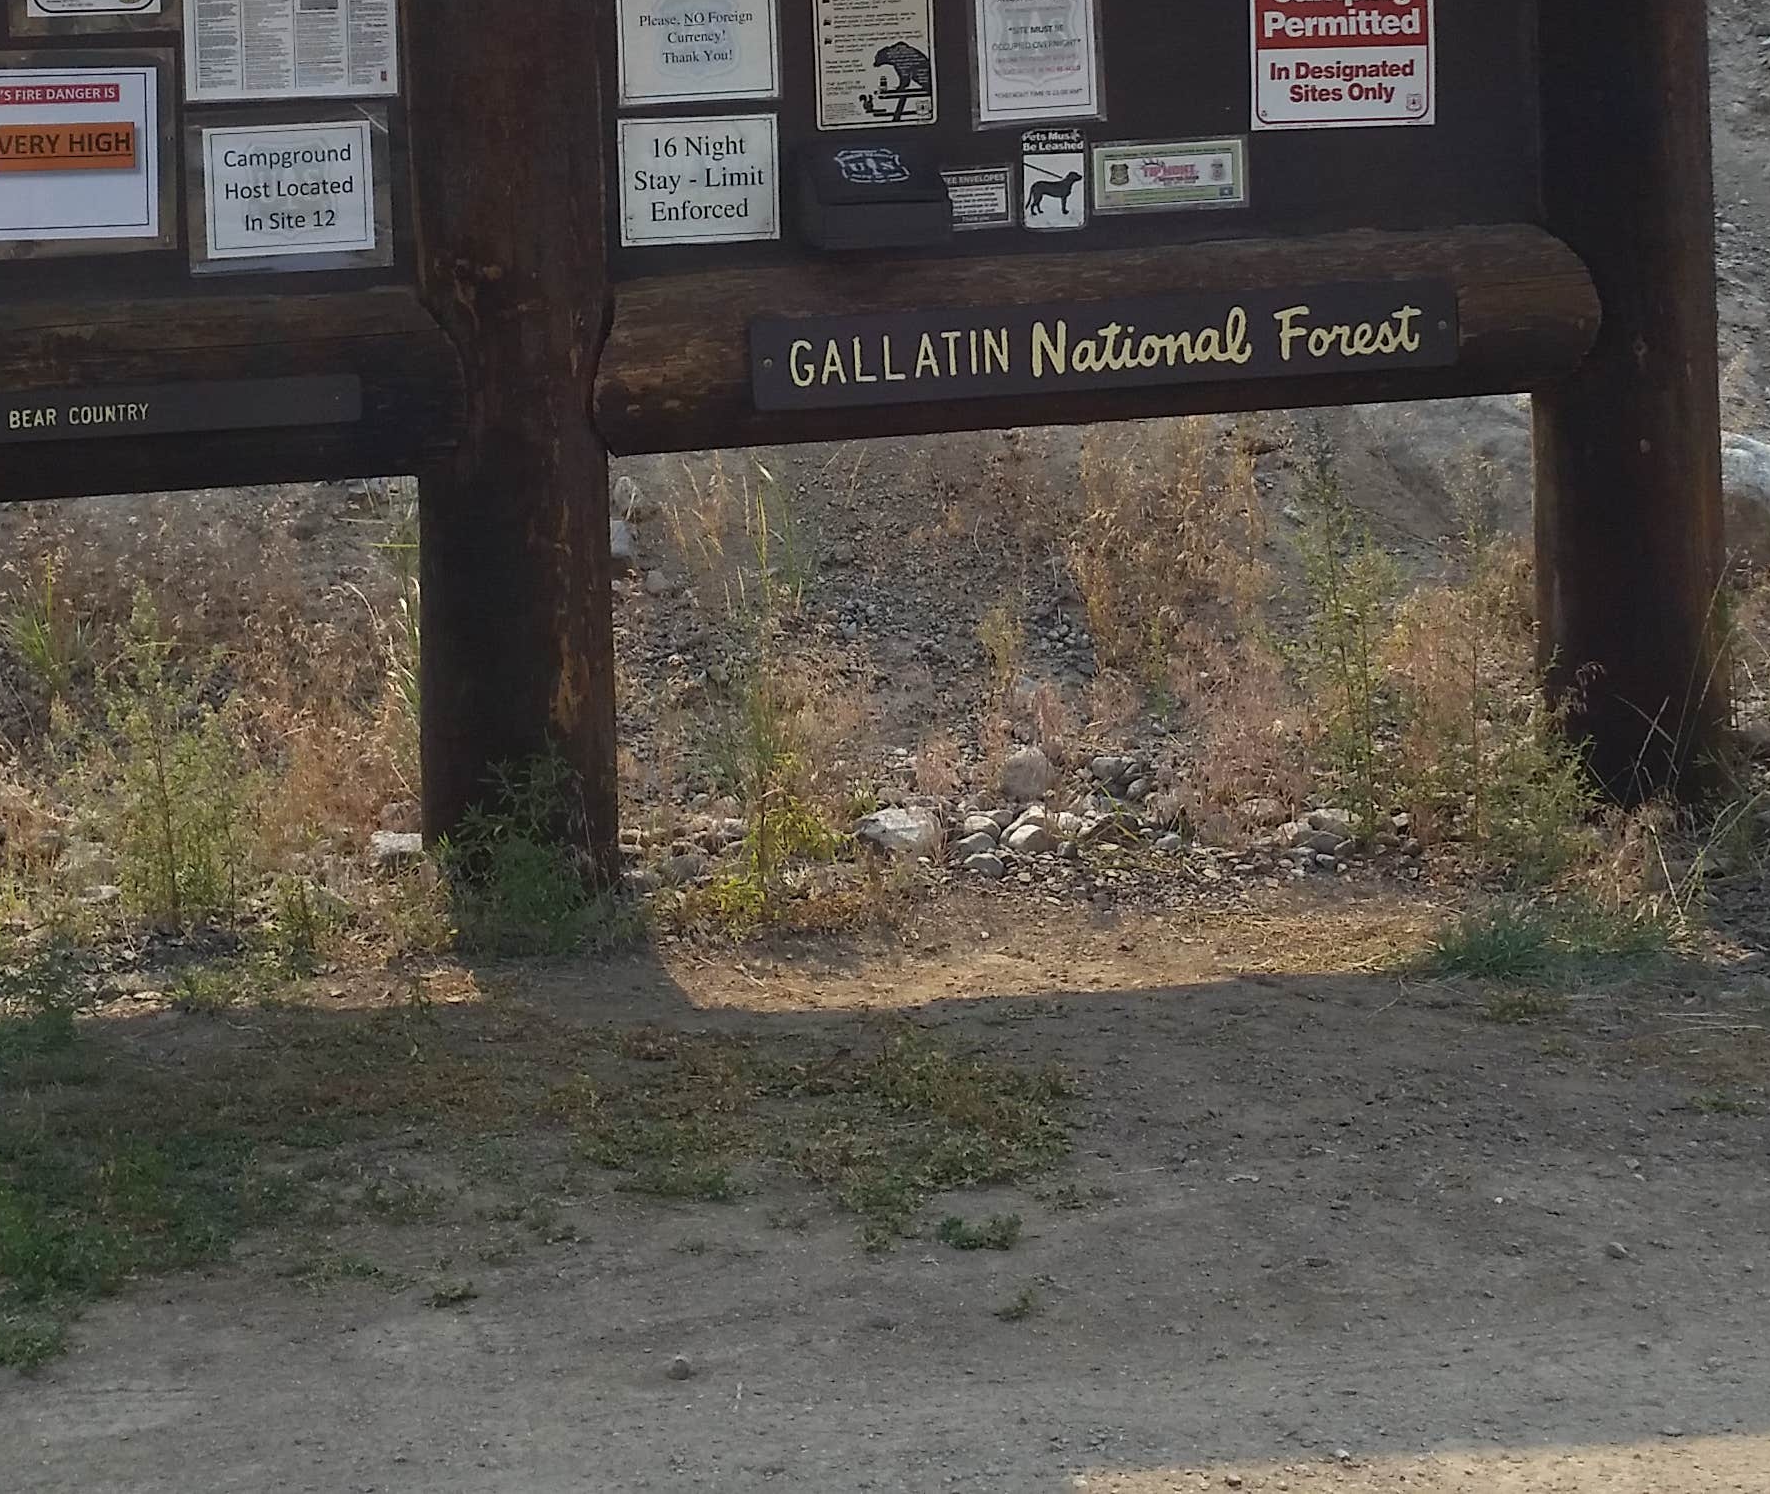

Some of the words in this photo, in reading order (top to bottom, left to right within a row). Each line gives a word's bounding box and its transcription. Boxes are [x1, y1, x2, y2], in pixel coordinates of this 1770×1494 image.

[684, 12, 705, 27] NO
[708, 10, 753, 26] Foreign
[1263, 8, 1421, 38] Permitted
[667, 30, 726, 44] Currency!
[662, 51, 700, 64] Thank
[703, 49, 733, 62] You!
[1270, 62, 1290, 81] In
[1294, 59, 1415, 83] Designated
[15, 89, 42, 101] FIRE
[45, 88, 101, 101] DANGER
[103, 87, 115, 99] IS
[1289, 85, 1343, 103] Sites
[1347, 82, 1396, 104] Only
[68, 131, 131, 153] HIGH
[653, 137, 678, 158] 16
[685, 135, 746, 161] Night
[1022, 132, 1047, 142] Pets
[1023, 142, 1037, 152] Be
[1038, 141, 1084, 151] Leashed
[223, 143, 352, 170] Campground
[225, 182, 271, 200] Host
[277, 175, 354, 197] Located
[634, 170, 681, 195] Stay
[704, 165, 765, 188] Limit
[959, 173, 1006, 184] ENVELOPES
[245, 214, 263, 232] In
[269, 212, 307, 230] Site
[313, 209, 336, 228] 12
[651, 197, 749, 222] Enforced
[789, 327, 1011, 388] GALLATIN
[1031, 306, 1252, 379] National
[1274, 305, 1423, 362] Forest
[8, 408, 57, 430] BEAR
[68, 402, 149, 425] COUNTRY
